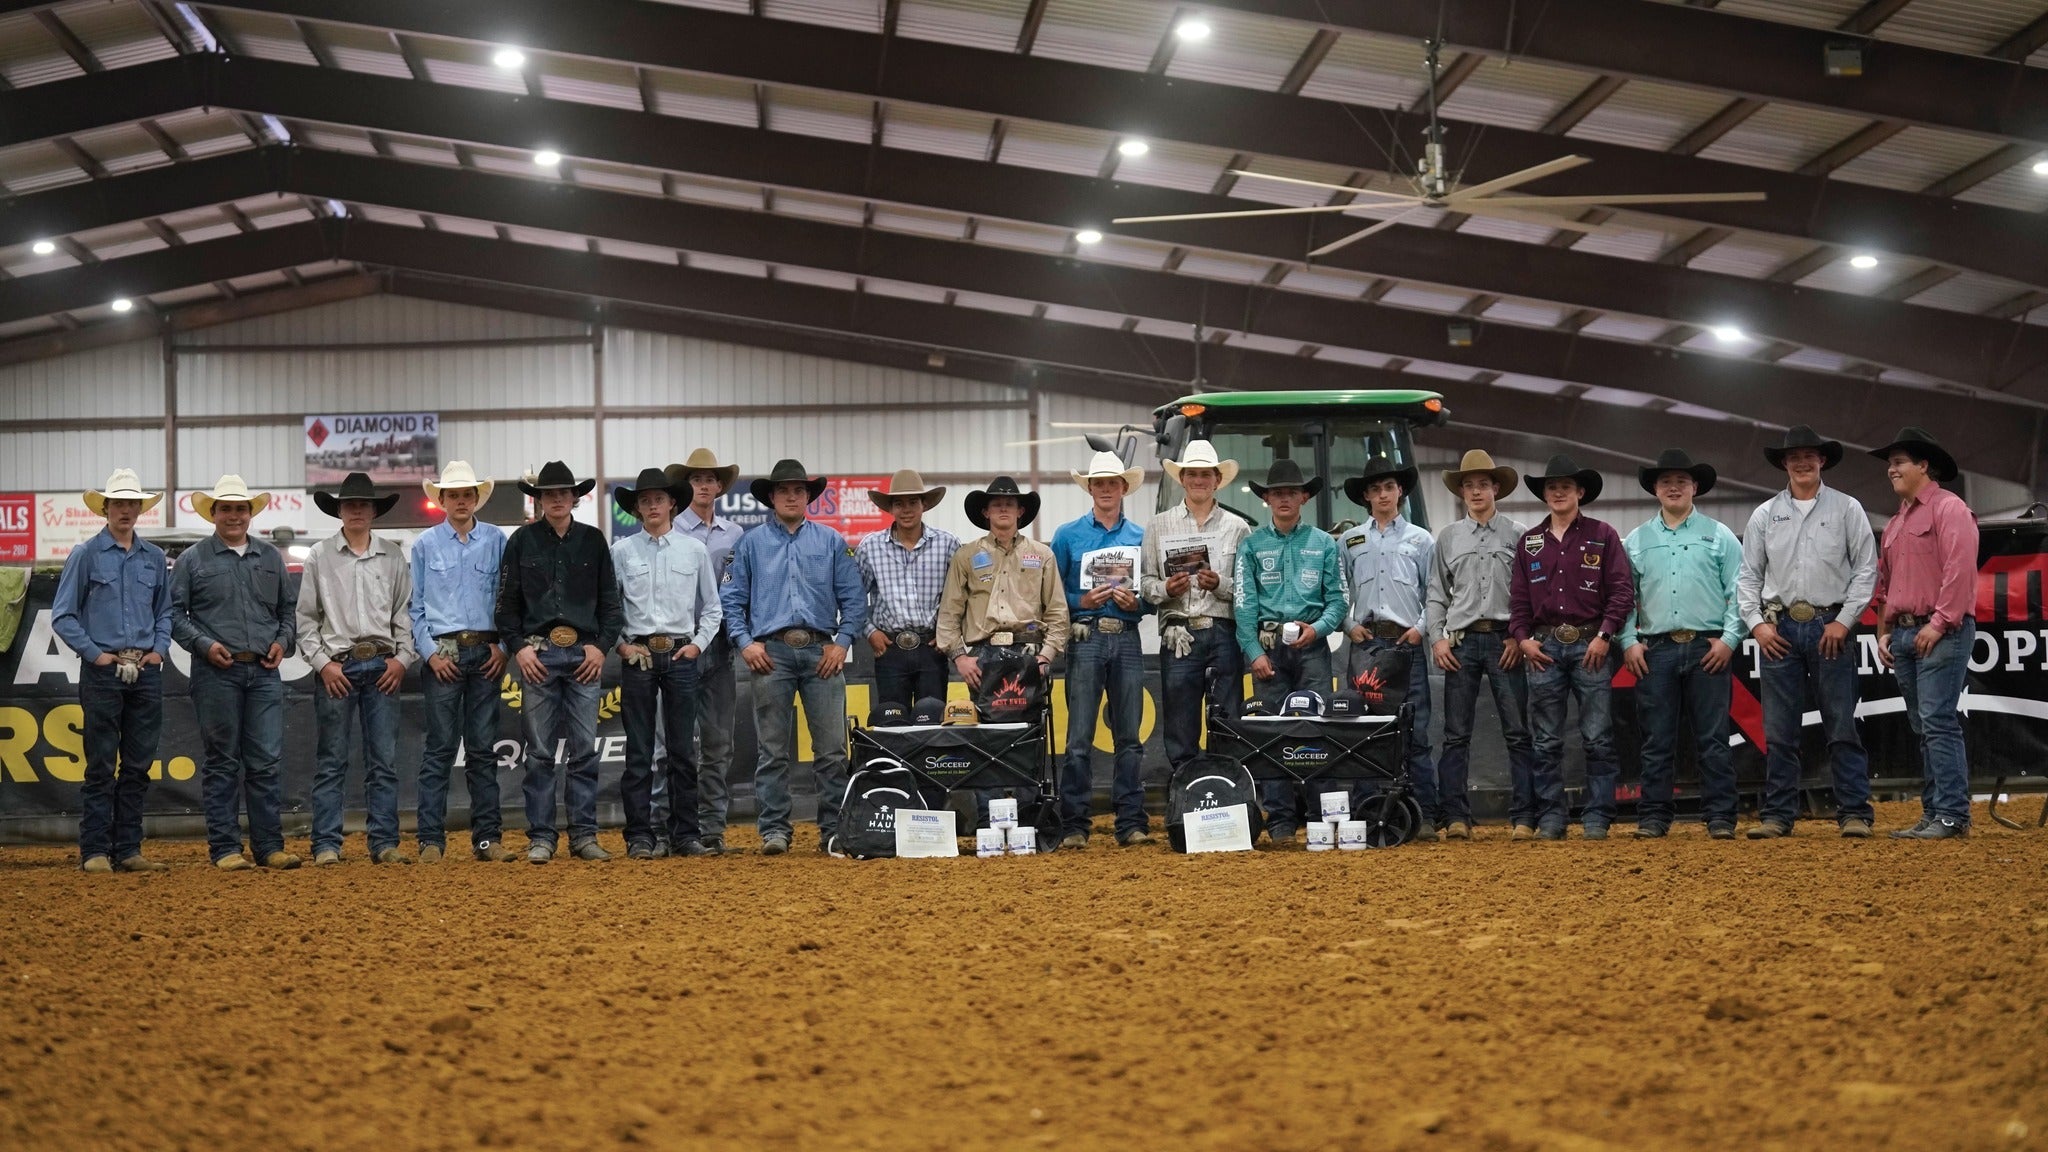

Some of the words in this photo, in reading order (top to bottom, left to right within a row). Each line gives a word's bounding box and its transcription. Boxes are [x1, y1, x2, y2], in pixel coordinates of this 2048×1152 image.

[335, 418, 417, 434] DIAMOND
[423, 415, 435, 431] R
[731, 514, 768, 524] CREDIT
[1234, 556, 1246, 608] Wrangler
[947, 705, 973, 715] Classic
[1200, 799, 1218, 807] TIN
[874, 812, 894, 820] TIN
[911, 814, 939, 822] RESISTOL
[1201, 811, 1230, 821] RESISTOL
